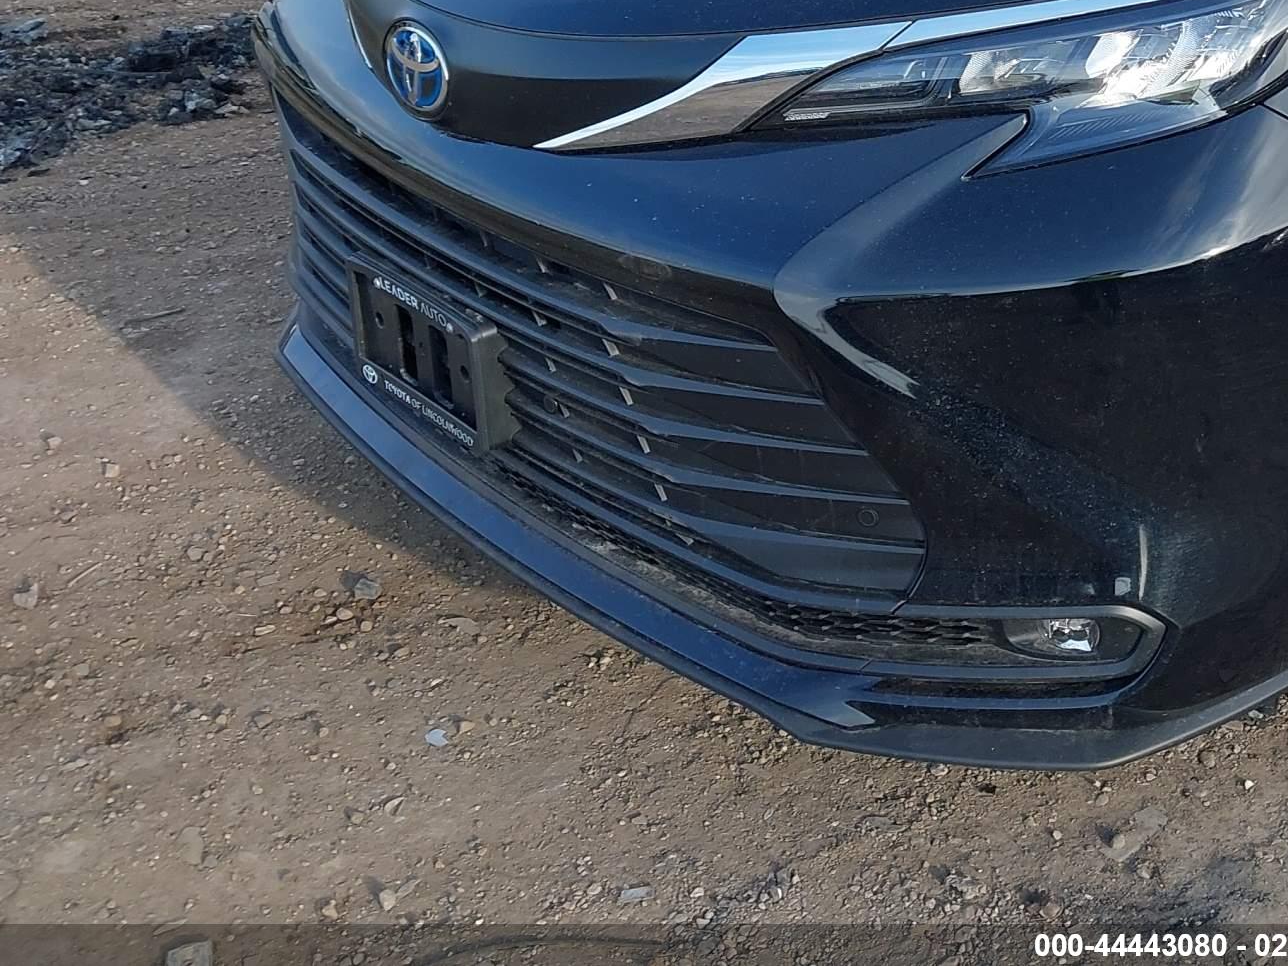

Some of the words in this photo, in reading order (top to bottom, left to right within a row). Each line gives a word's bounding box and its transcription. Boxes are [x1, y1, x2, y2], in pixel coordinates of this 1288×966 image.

[378, 276, 419, 310] LEADER
[420, 302, 447, 327] AUTO
[383, 379, 411, 404] TOYOTA
[411, 398, 421, 409] OF
[422, 404, 474, 447] LINCOLNWOOD
